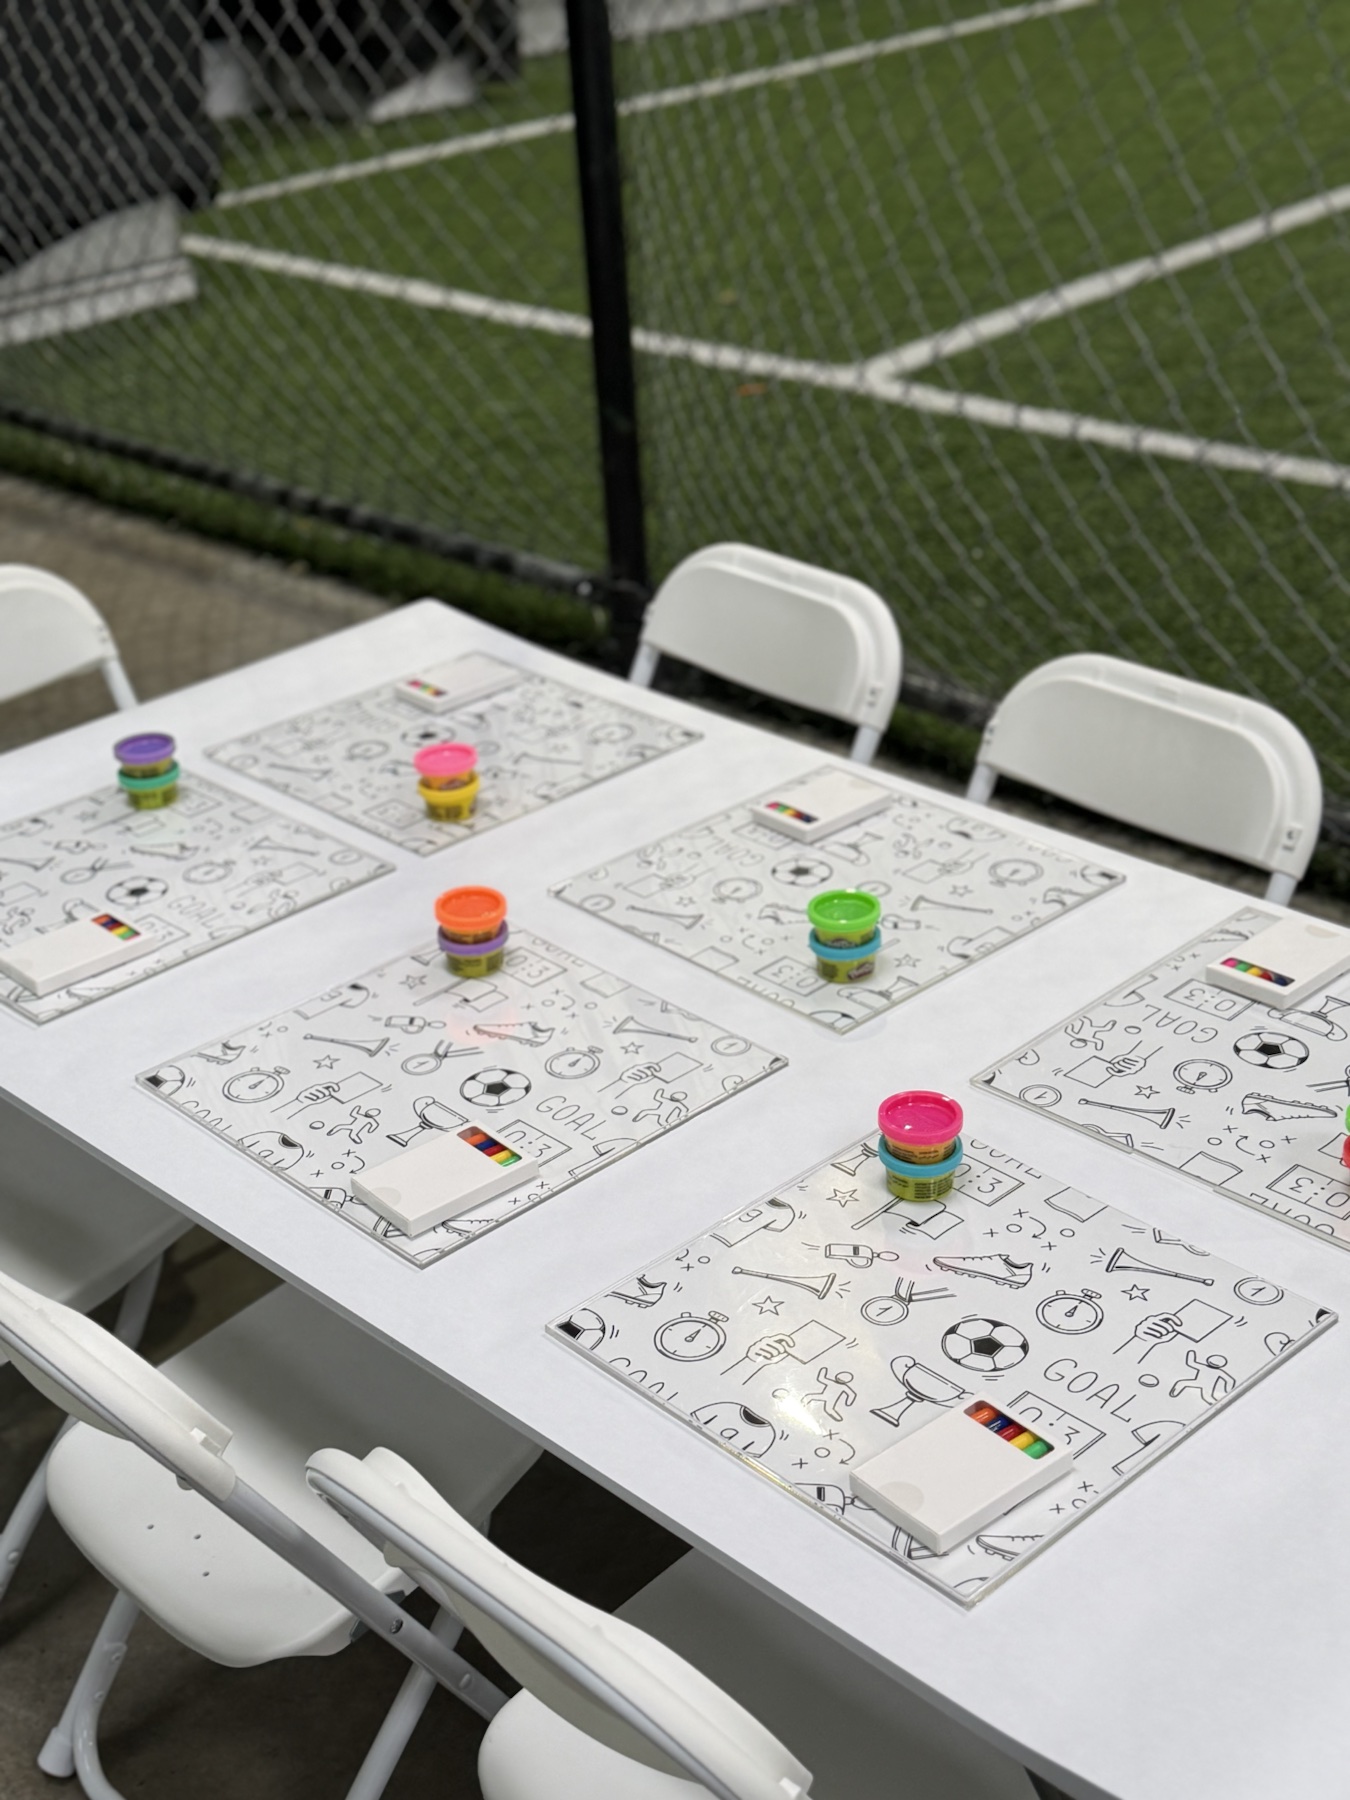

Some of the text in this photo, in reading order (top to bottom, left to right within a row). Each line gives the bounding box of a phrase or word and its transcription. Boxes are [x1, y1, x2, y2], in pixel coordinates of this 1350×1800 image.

[505, 954, 550, 979] 0:3
[1183, 987, 1237, 1012] 0:3
[1141, 1003, 1219, 1044] GOAL
[535, 1095, 607, 1141] GOAL
[1288, 1176, 1350, 1208] 0:3
[1043, 1357, 1137, 1424] GOAL
